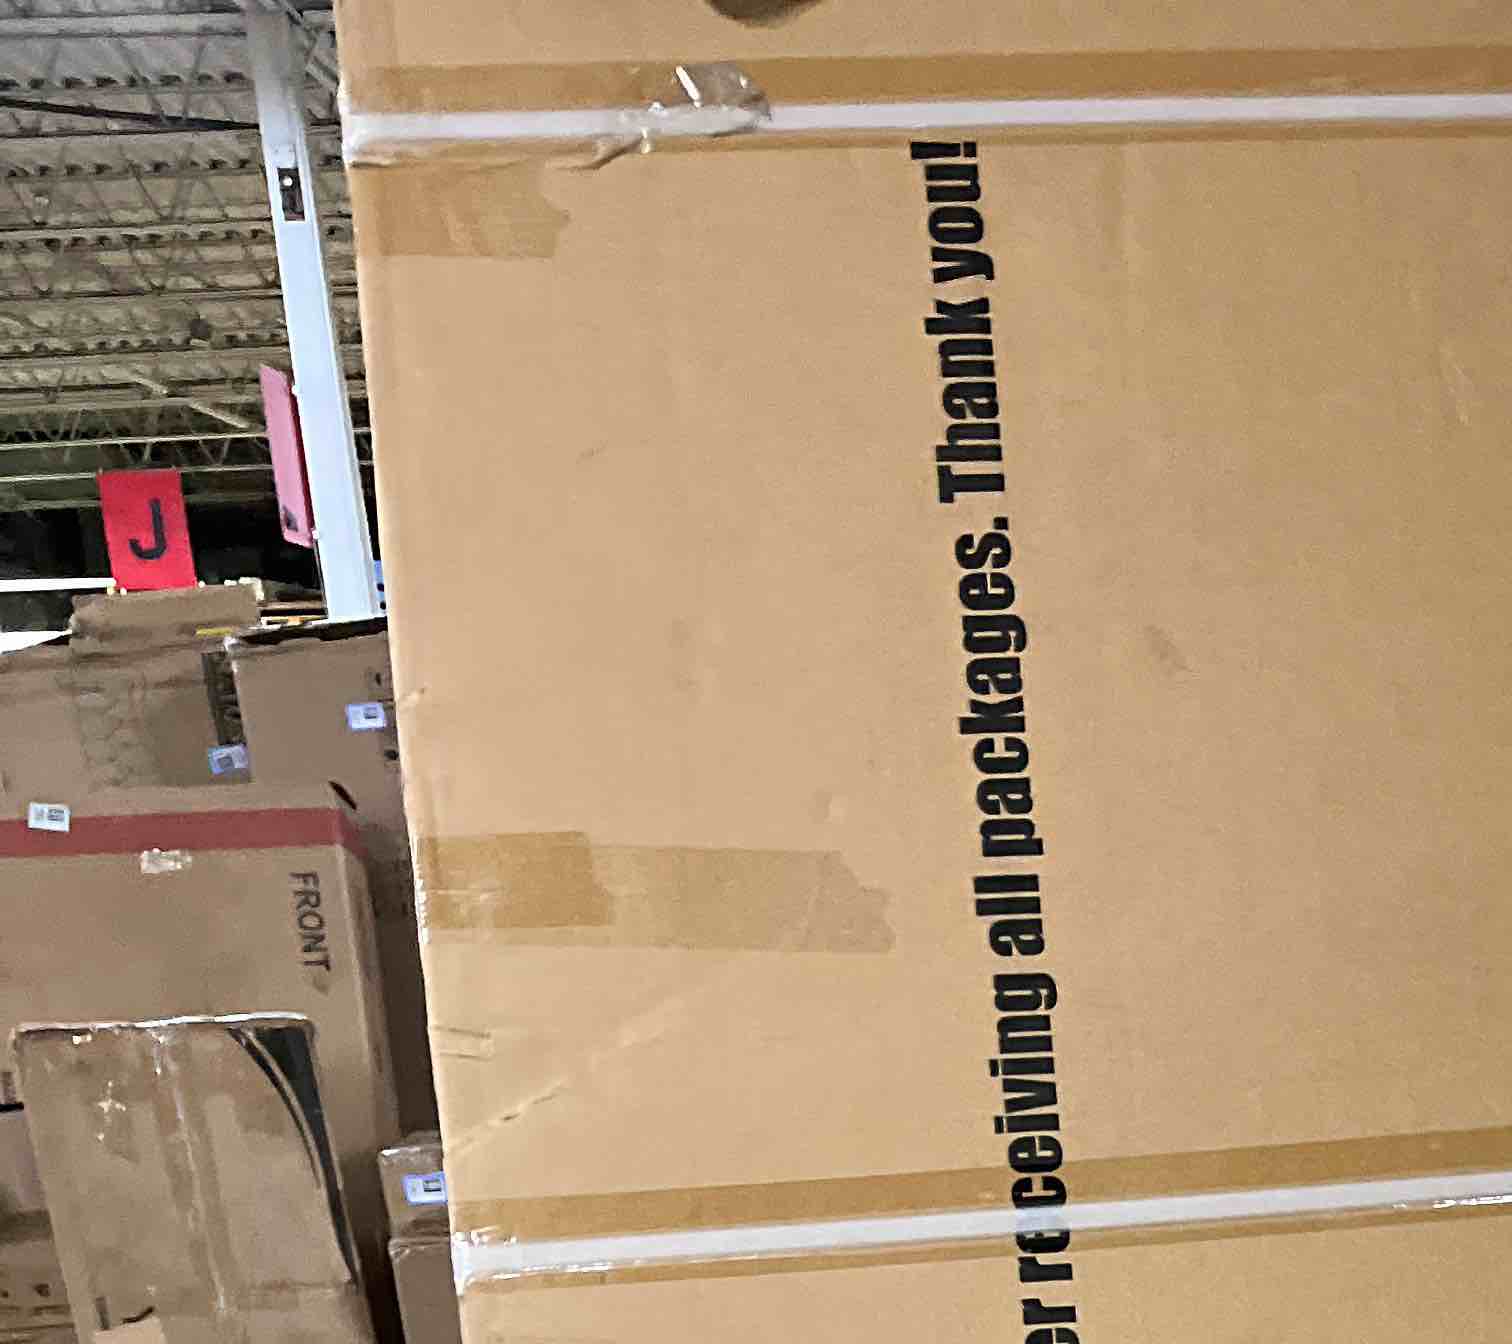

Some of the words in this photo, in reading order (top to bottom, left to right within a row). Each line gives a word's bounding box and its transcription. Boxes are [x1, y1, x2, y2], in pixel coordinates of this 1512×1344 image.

[910, 142, 994, 283] you!
[925, 298, 1005, 503] Thank
[130, 500, 167, 560] J
[956, 517, 1043, 857] packages.
[289, 871, 331, 972] FRONT
[974, 875, 1044, 956] all
